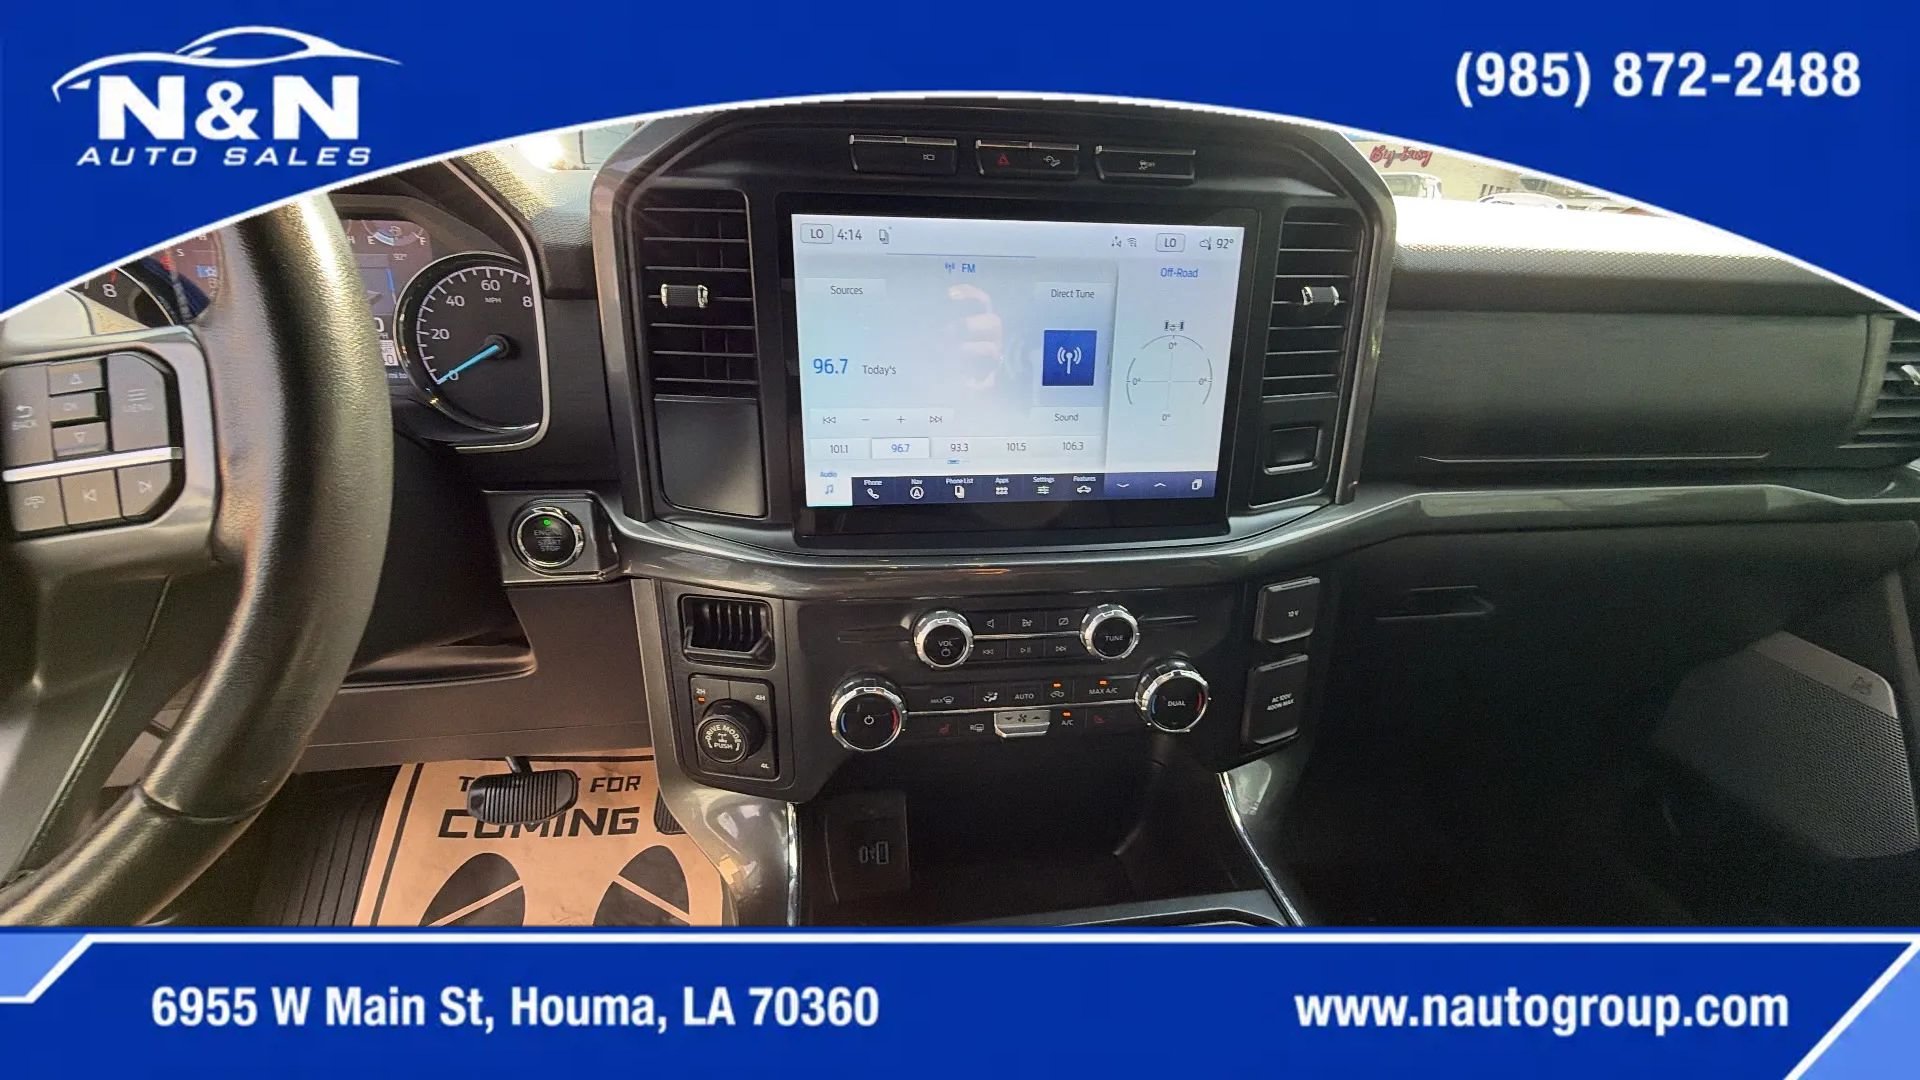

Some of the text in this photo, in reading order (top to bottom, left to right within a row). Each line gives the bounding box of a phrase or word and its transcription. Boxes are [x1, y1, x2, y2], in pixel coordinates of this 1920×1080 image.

[810, 229, 824, 239] LO
[837, 229, 863, 240] 4:14
[1164, 237, 1177, 248] LO
[1216, 238, 1234, 249] 92°
[961, 263, 976, 273] FM
[1160, 267, 1199, 279] Off-Road
[480, 279, 501, 291] 60
[830, 285, 864, 296] Sources
[1050, 288, 1096, 299] Direct Tune
[445, 295, 465, 307] 40
[484, 296, 502, 304] MPH
[430, 328, 450, 340] 20
[813, 358, 849, 375] 96.7
[861, 364, 897, 376] Today's
[1054, 413, 1079, 423] Sound
[830, 444, 849, 454] 101.1
[890, 443, 910, 453] 96.7
[950, 443, 969, 452] 93.3
[1006, 442, 1027, 452] 101.5
[1062, 441, 1084, 451] 106.3
[820, 470, 838, 478] Audio
[937, 640, 953, 648] VOL
[1105, 686, 1118, 694] A/C
[1167, 699, 1186, 708] DUAL
[1061, 718, 1074, 727] A/C
[705, 724, 721, 742] DRIVE
[713, 742, 733, 750] PUSH
[589, 775, 642, 793] FOR
